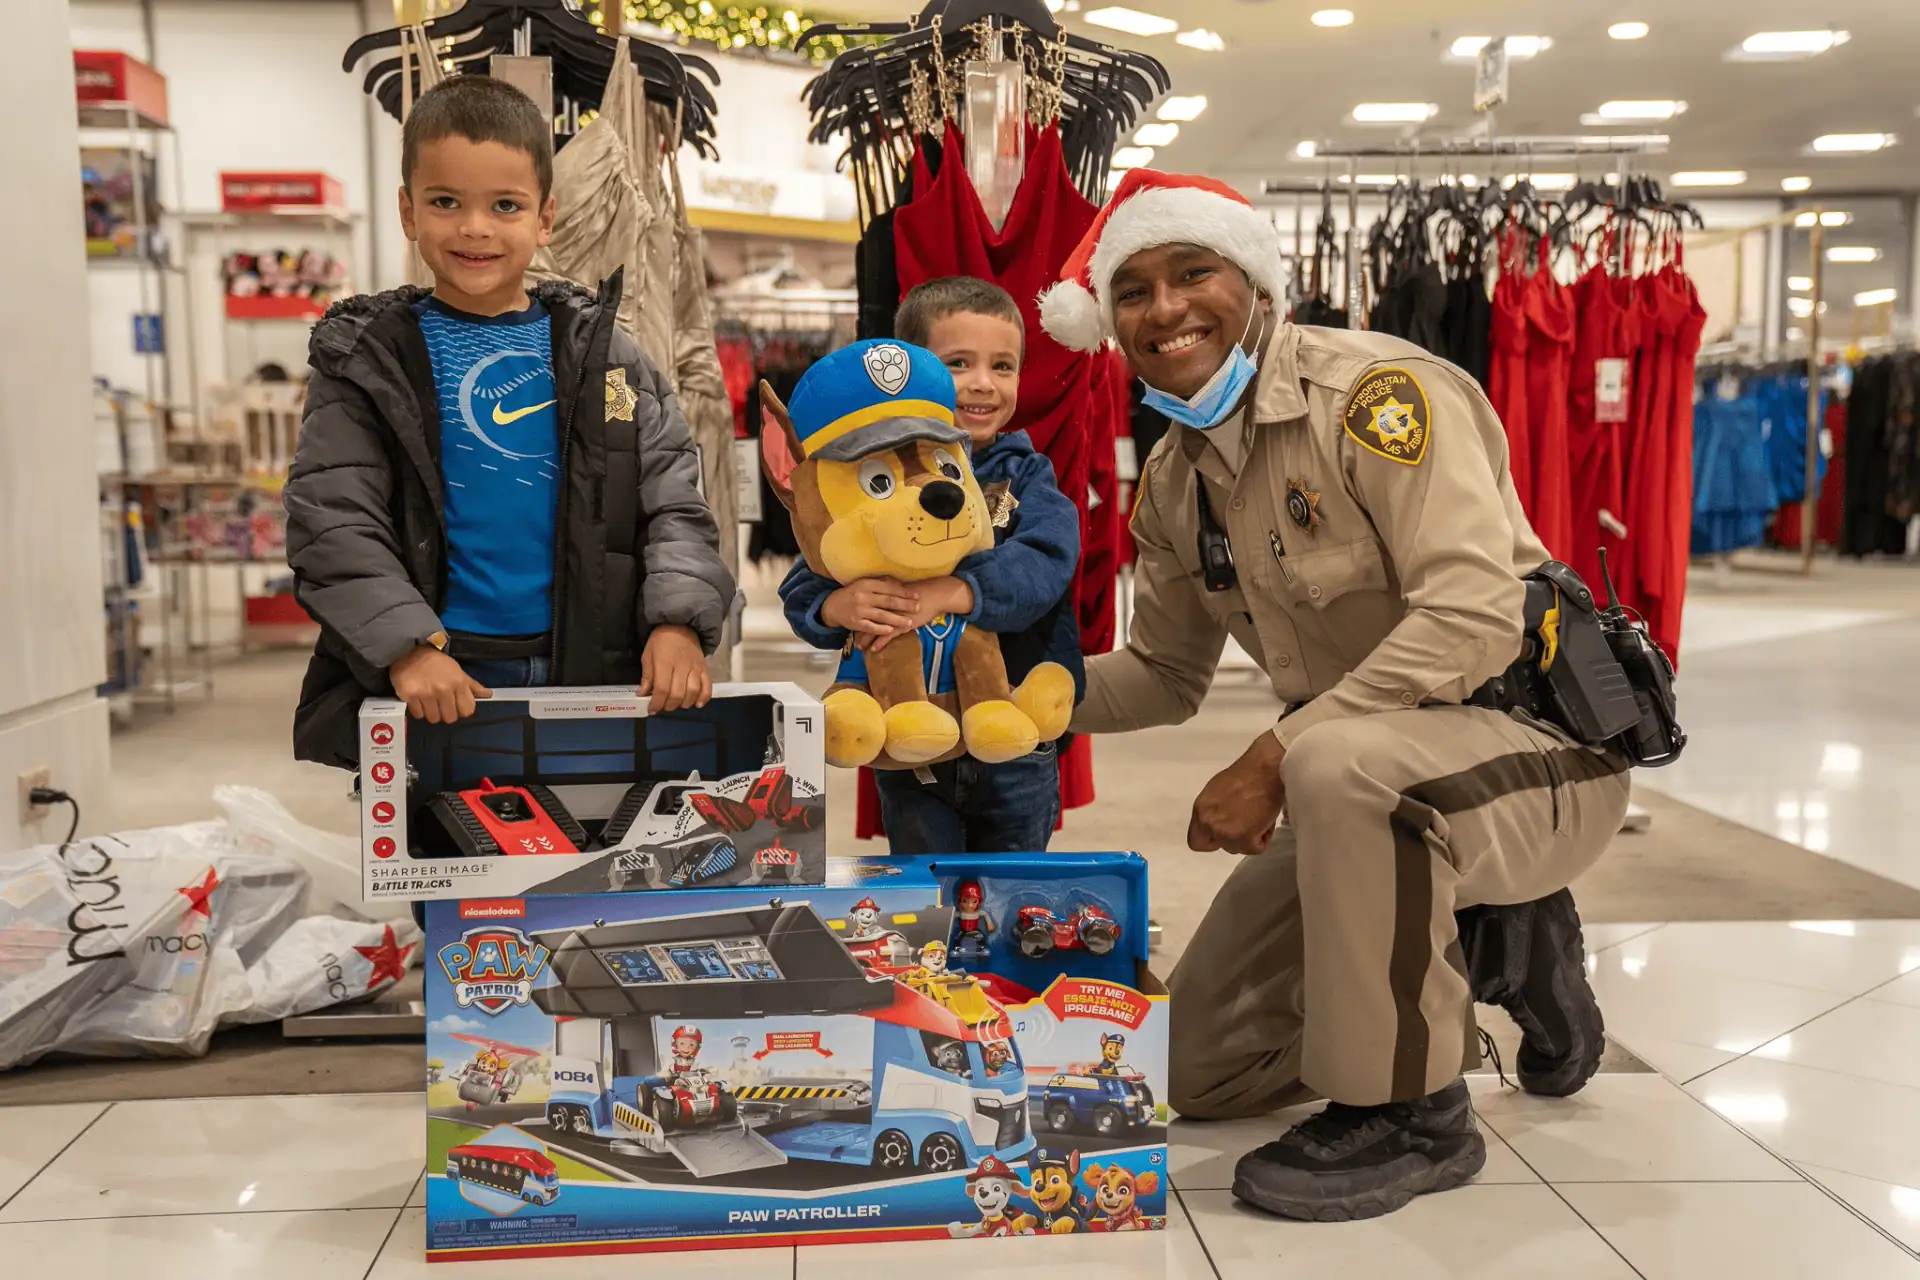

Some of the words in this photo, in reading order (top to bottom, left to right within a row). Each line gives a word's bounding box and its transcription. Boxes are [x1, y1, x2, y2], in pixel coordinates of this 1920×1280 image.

[1347, 375, 1407, 417] METROPOLITAN
[1360, 385, 1393, 408] POLICE
[1384, 442, 1401, 455] LAS
[1403, 428, 1423, 453] VEGAS
[722, 775, 751, 789] LAUNCH
[802, 779, 818, 794] WIN!
[675, 805, 691, 831] SCOOP
[371, 866, 438, 878] SHARPER
[444, 863, 489, 875] IMAGE
[464, 907, 520, 917] nickelodeon
[437, 940, 550, 984] PAW
[465, 984, 523, 998] PATROL
[1079, 985, 1104, 995] TRY
[1104, 987, 1126, 1000] ME!
[728, 1209, 769, 1223] PAW
[489, 1219, 529, 1230] WARNING:
